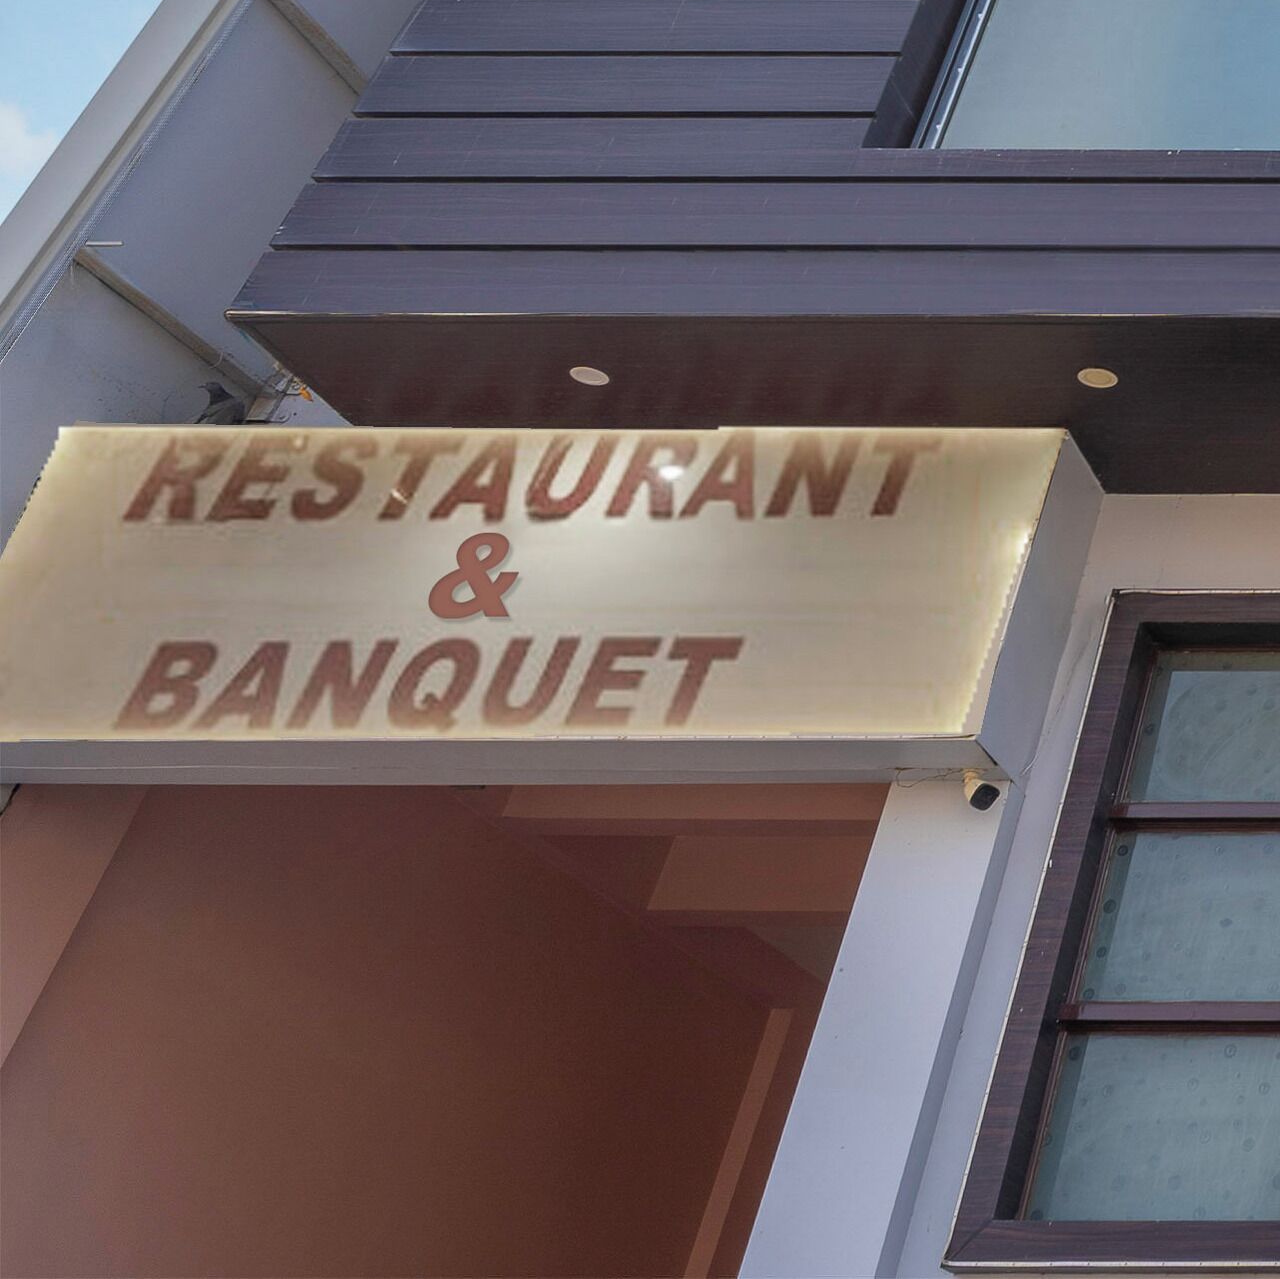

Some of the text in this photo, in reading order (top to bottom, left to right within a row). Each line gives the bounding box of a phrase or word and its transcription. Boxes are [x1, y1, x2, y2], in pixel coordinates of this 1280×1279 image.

[122, 429, 942, 522] RESTAURANT
[428, 532, 519, 620] &
[112, 636, 745, 730] BANQUET
